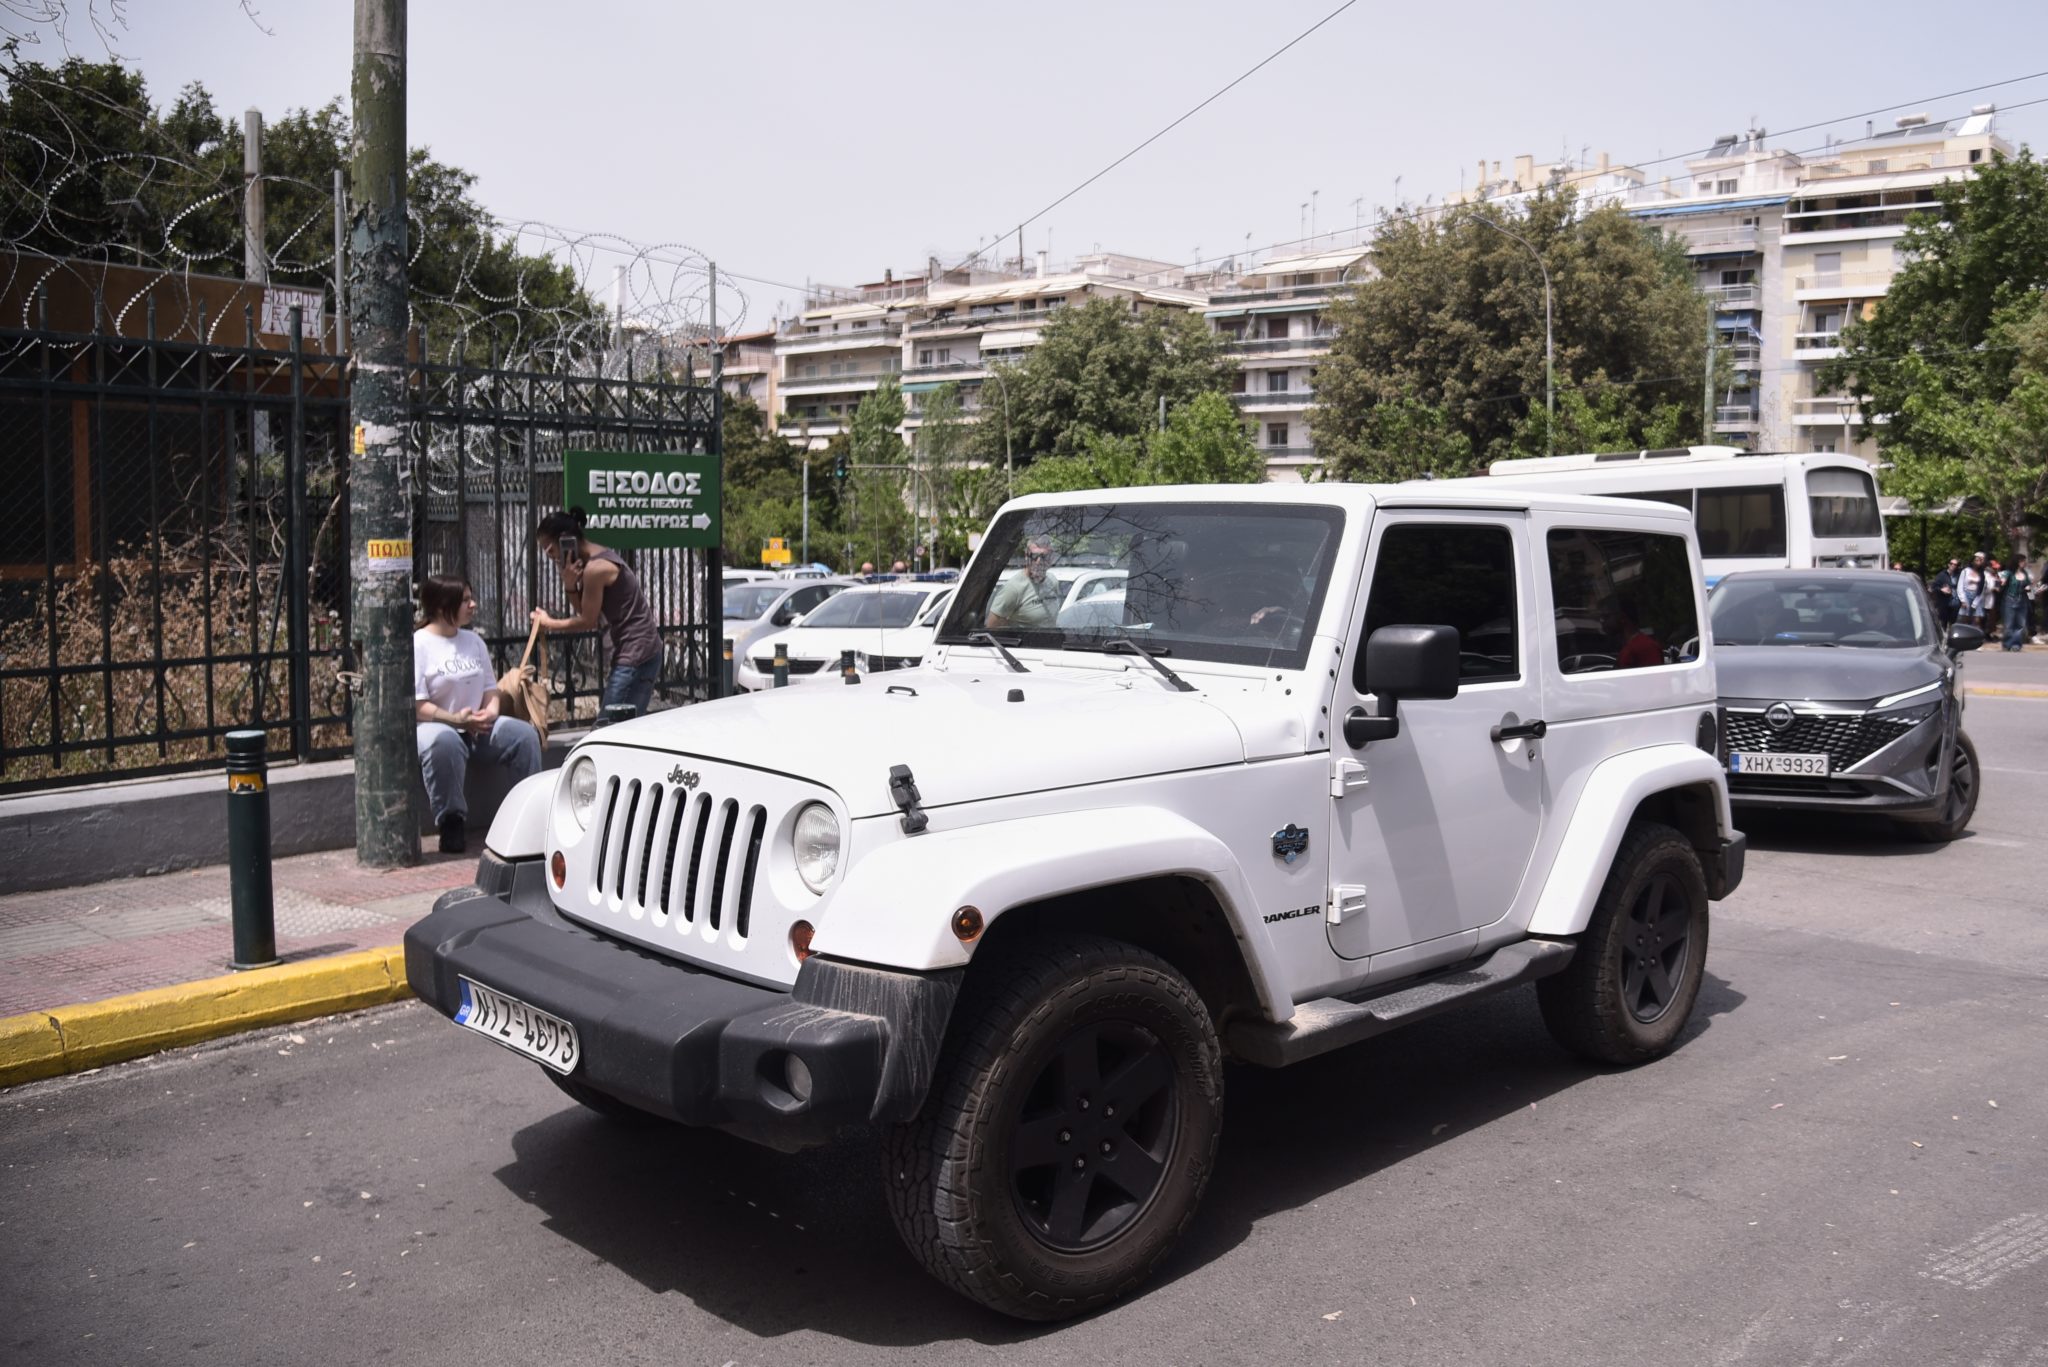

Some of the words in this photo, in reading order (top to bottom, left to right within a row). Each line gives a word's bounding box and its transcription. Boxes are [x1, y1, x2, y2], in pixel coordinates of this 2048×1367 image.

[589, 470, 701, 495] ΕΙΣΟΔΟΣ
[598, 498, 617, 508] ΓΙΑ
[619, 498, 648, 509] ΤΟΥΣ
[650, 498, 693, 509] ΠΕΖΟΥΣ
[667, 763, 701, 791] Jeep
[1263, 905, 1320, 924] RANGLER
